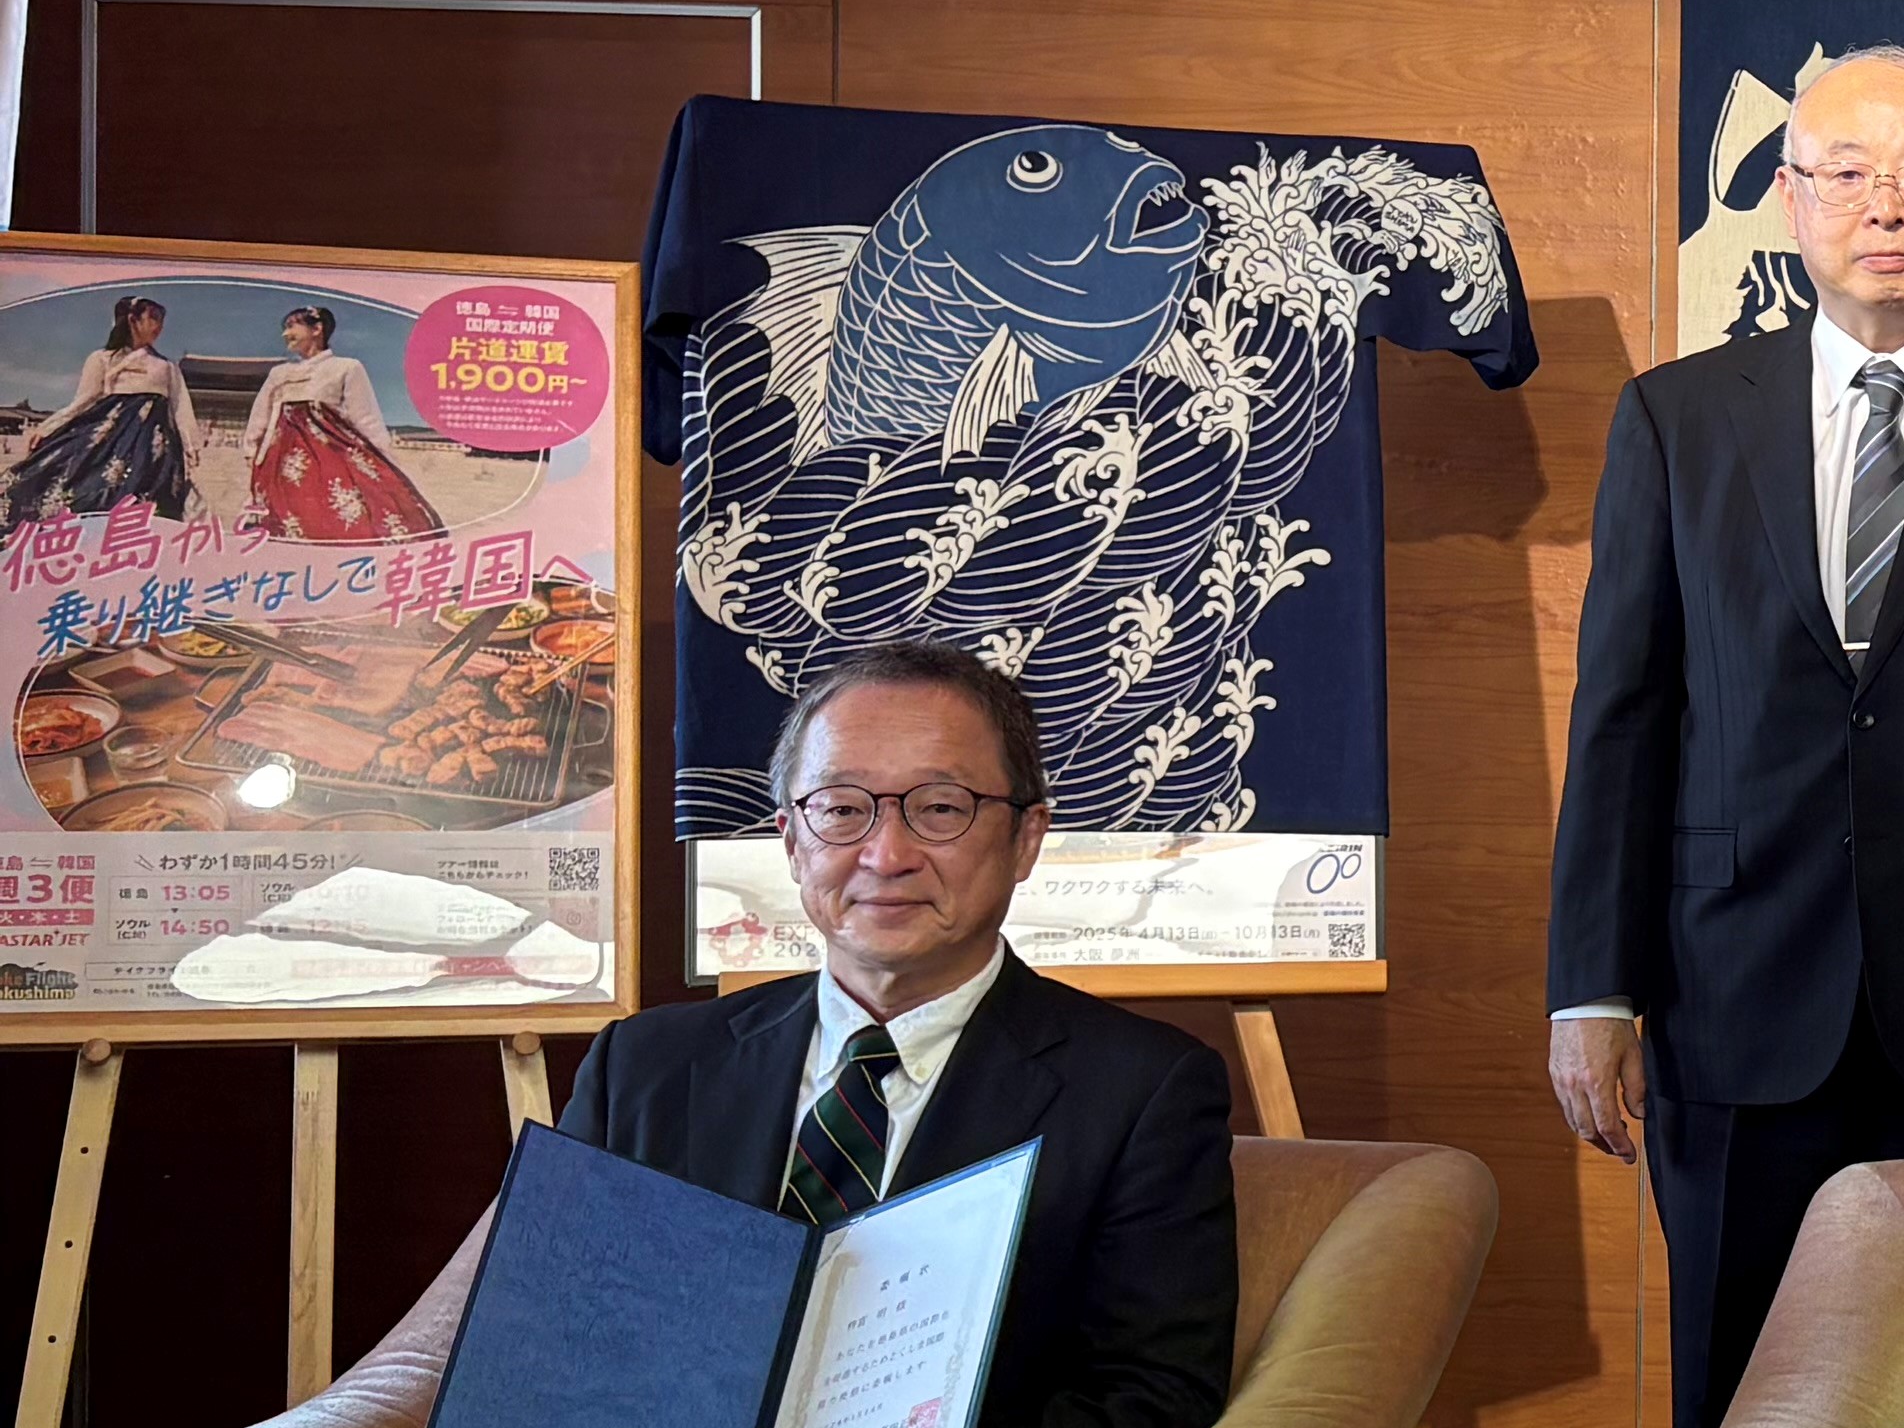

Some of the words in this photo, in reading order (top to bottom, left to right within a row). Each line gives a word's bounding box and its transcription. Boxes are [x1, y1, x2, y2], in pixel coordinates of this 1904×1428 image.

[525, 304, 560, 320] 韓国
[465, 317, 555, 336] 国際定期便
[448, 336, 569, 365] 片道運賃
[3, 494, 270, 592] 徳島から
[57, 855, 95, 870] 韓国
[162, 885, 231, 901] 13:05
[116, 919, 151, 930] ソウル
[160, 919, 231, 936] 14:50
[58, 934, 90, 946] JET
[774, 943, 817, 958] 202
